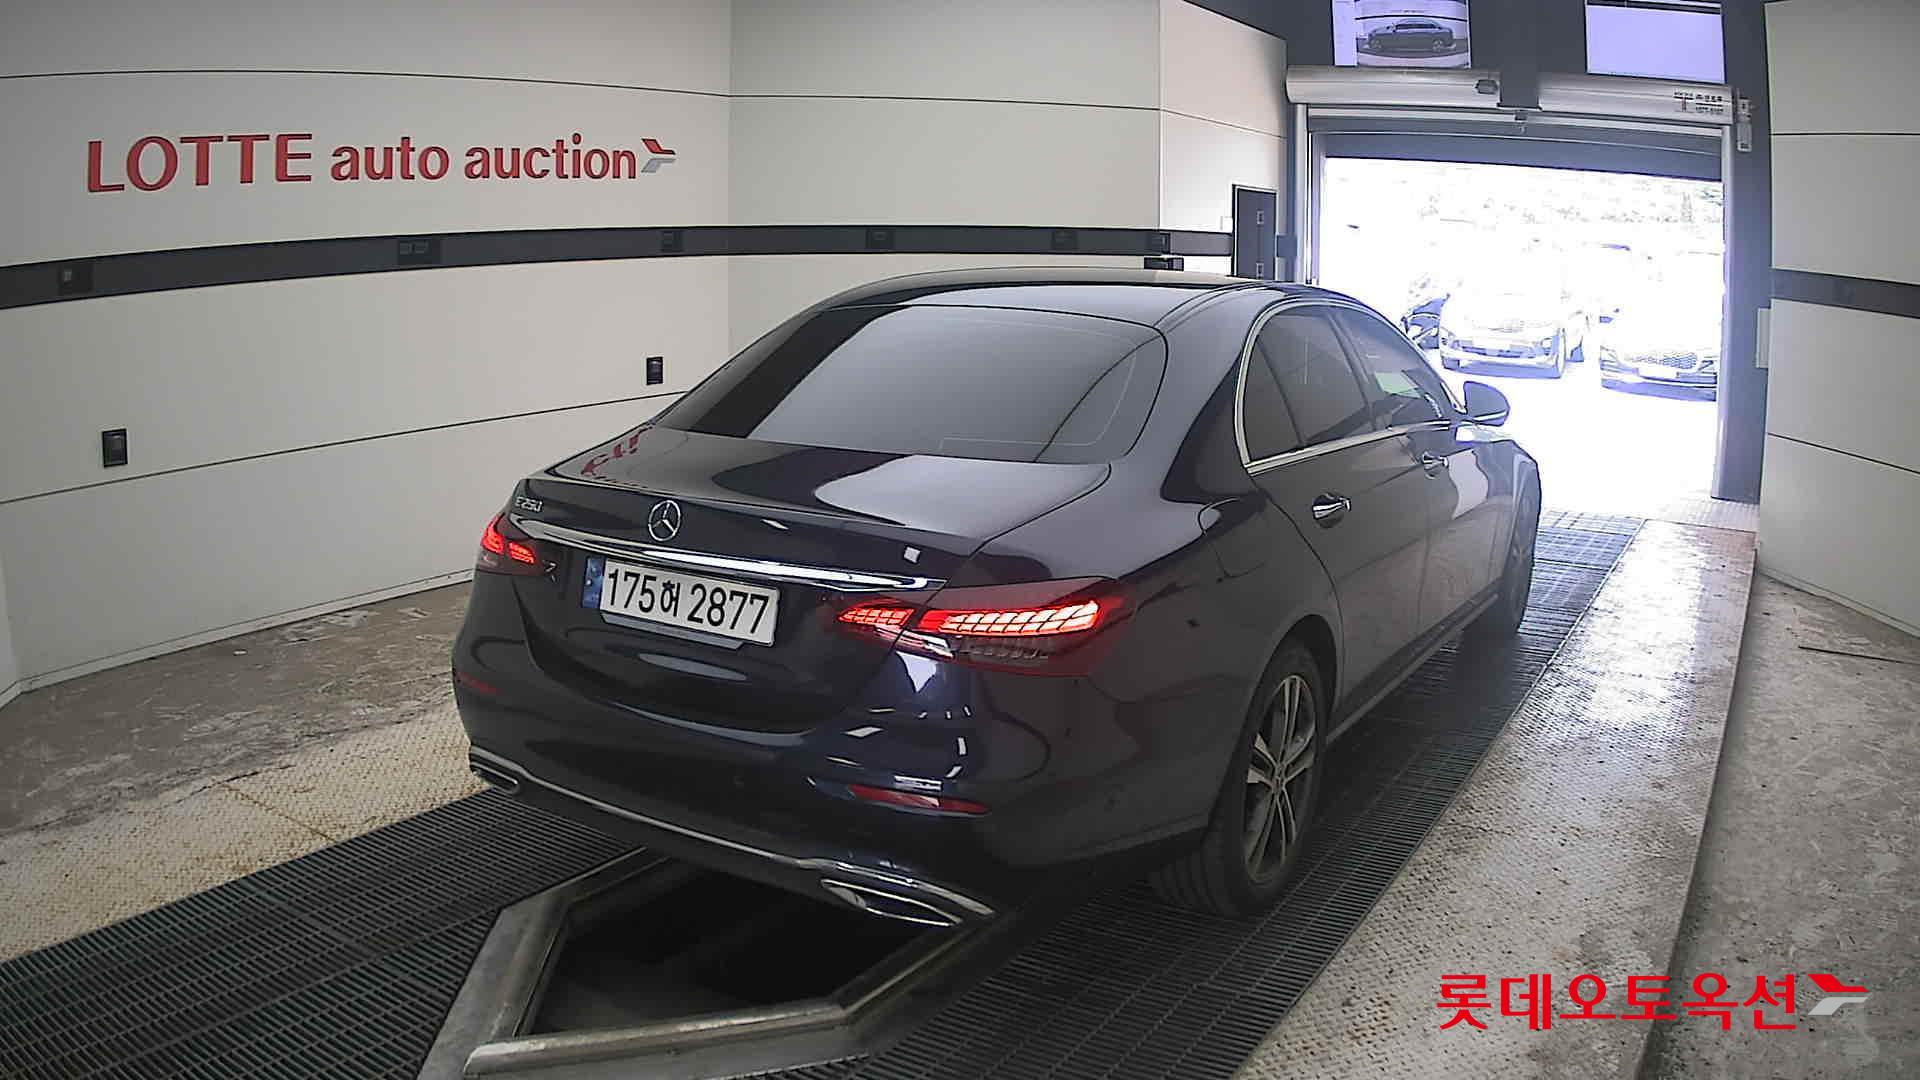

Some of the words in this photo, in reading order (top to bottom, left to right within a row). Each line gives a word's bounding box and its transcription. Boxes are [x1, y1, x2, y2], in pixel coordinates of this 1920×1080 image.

[87, 133, 313, 193] LOTTE
[330, 136, 450, 181] auto
[463, 132, 637, 180] auction
[608, 568, 681, 617] 175허
[687, 583, 770, 634] 2877
